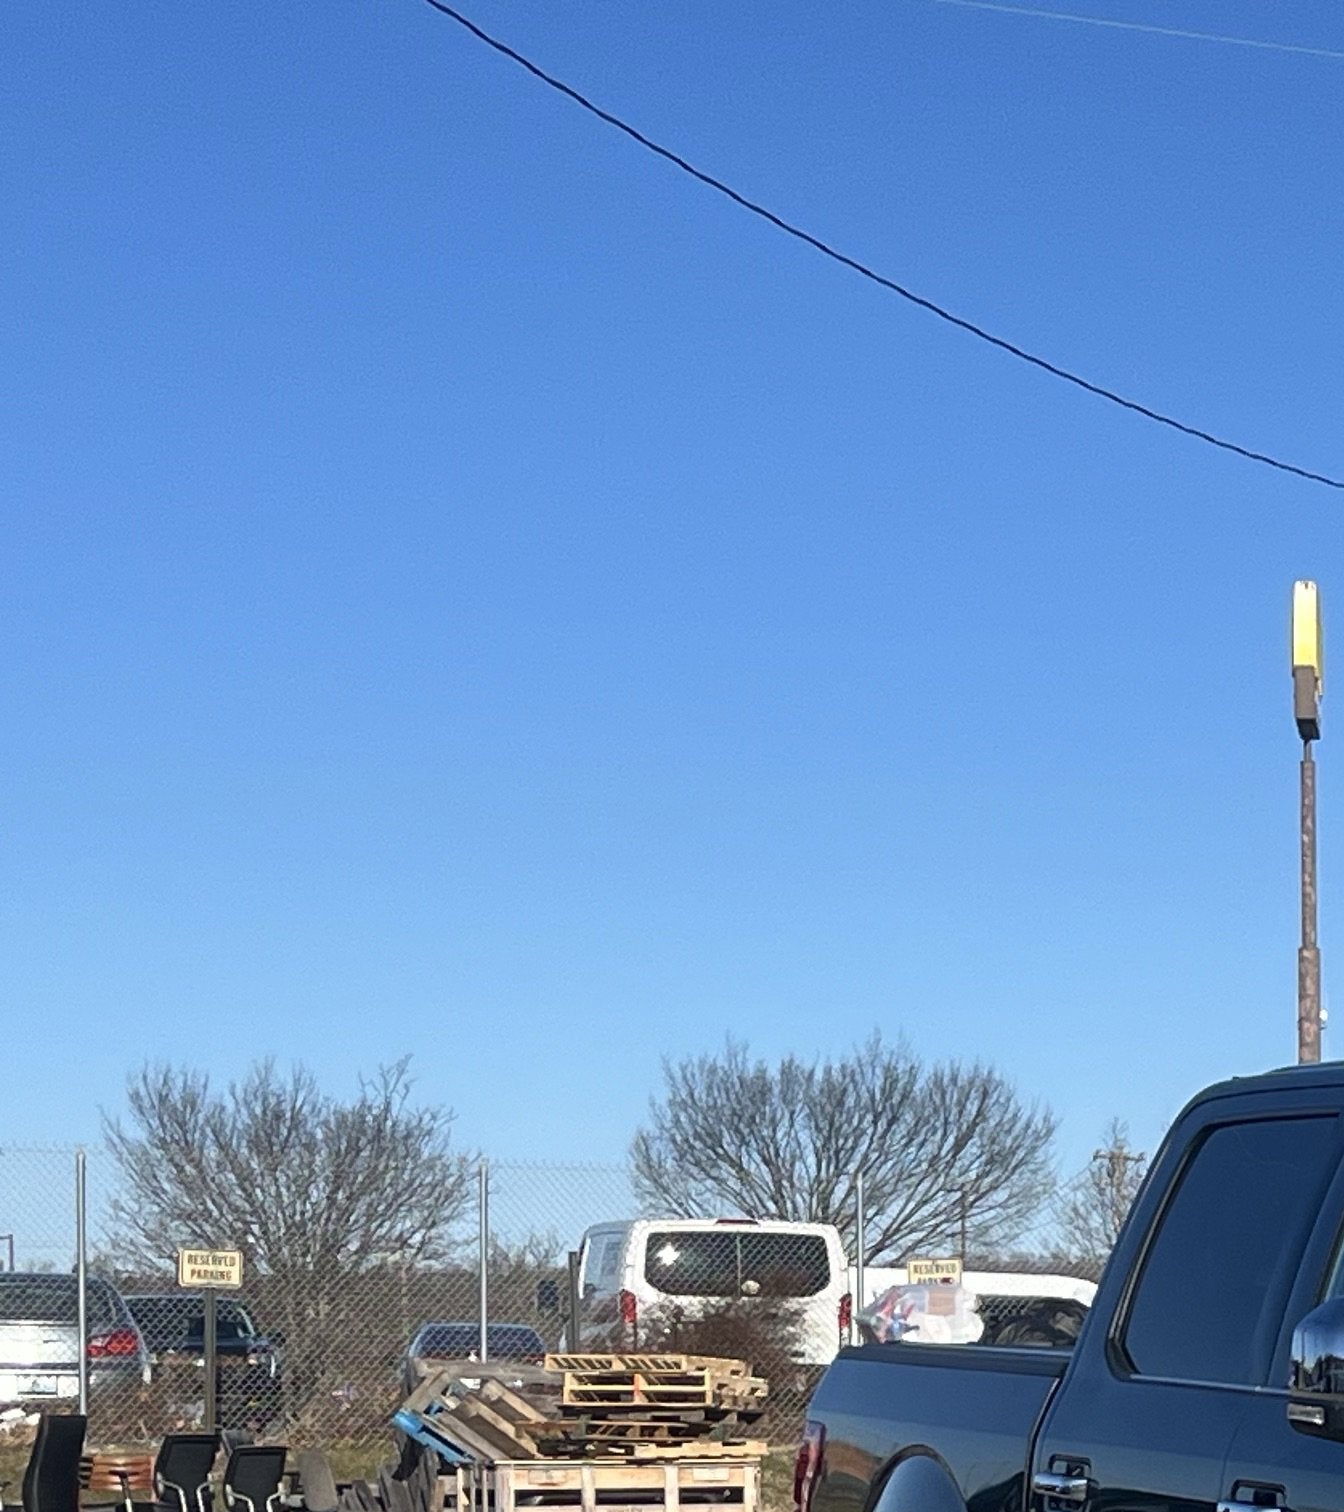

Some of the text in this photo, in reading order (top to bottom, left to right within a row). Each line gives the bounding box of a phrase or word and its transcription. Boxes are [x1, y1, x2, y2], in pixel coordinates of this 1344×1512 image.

[187, 1254, 237, 1267] RESERVED
[190, 1268, 233, 1281] PARKING
[913, 1263, 957, 1275] RESERVED
